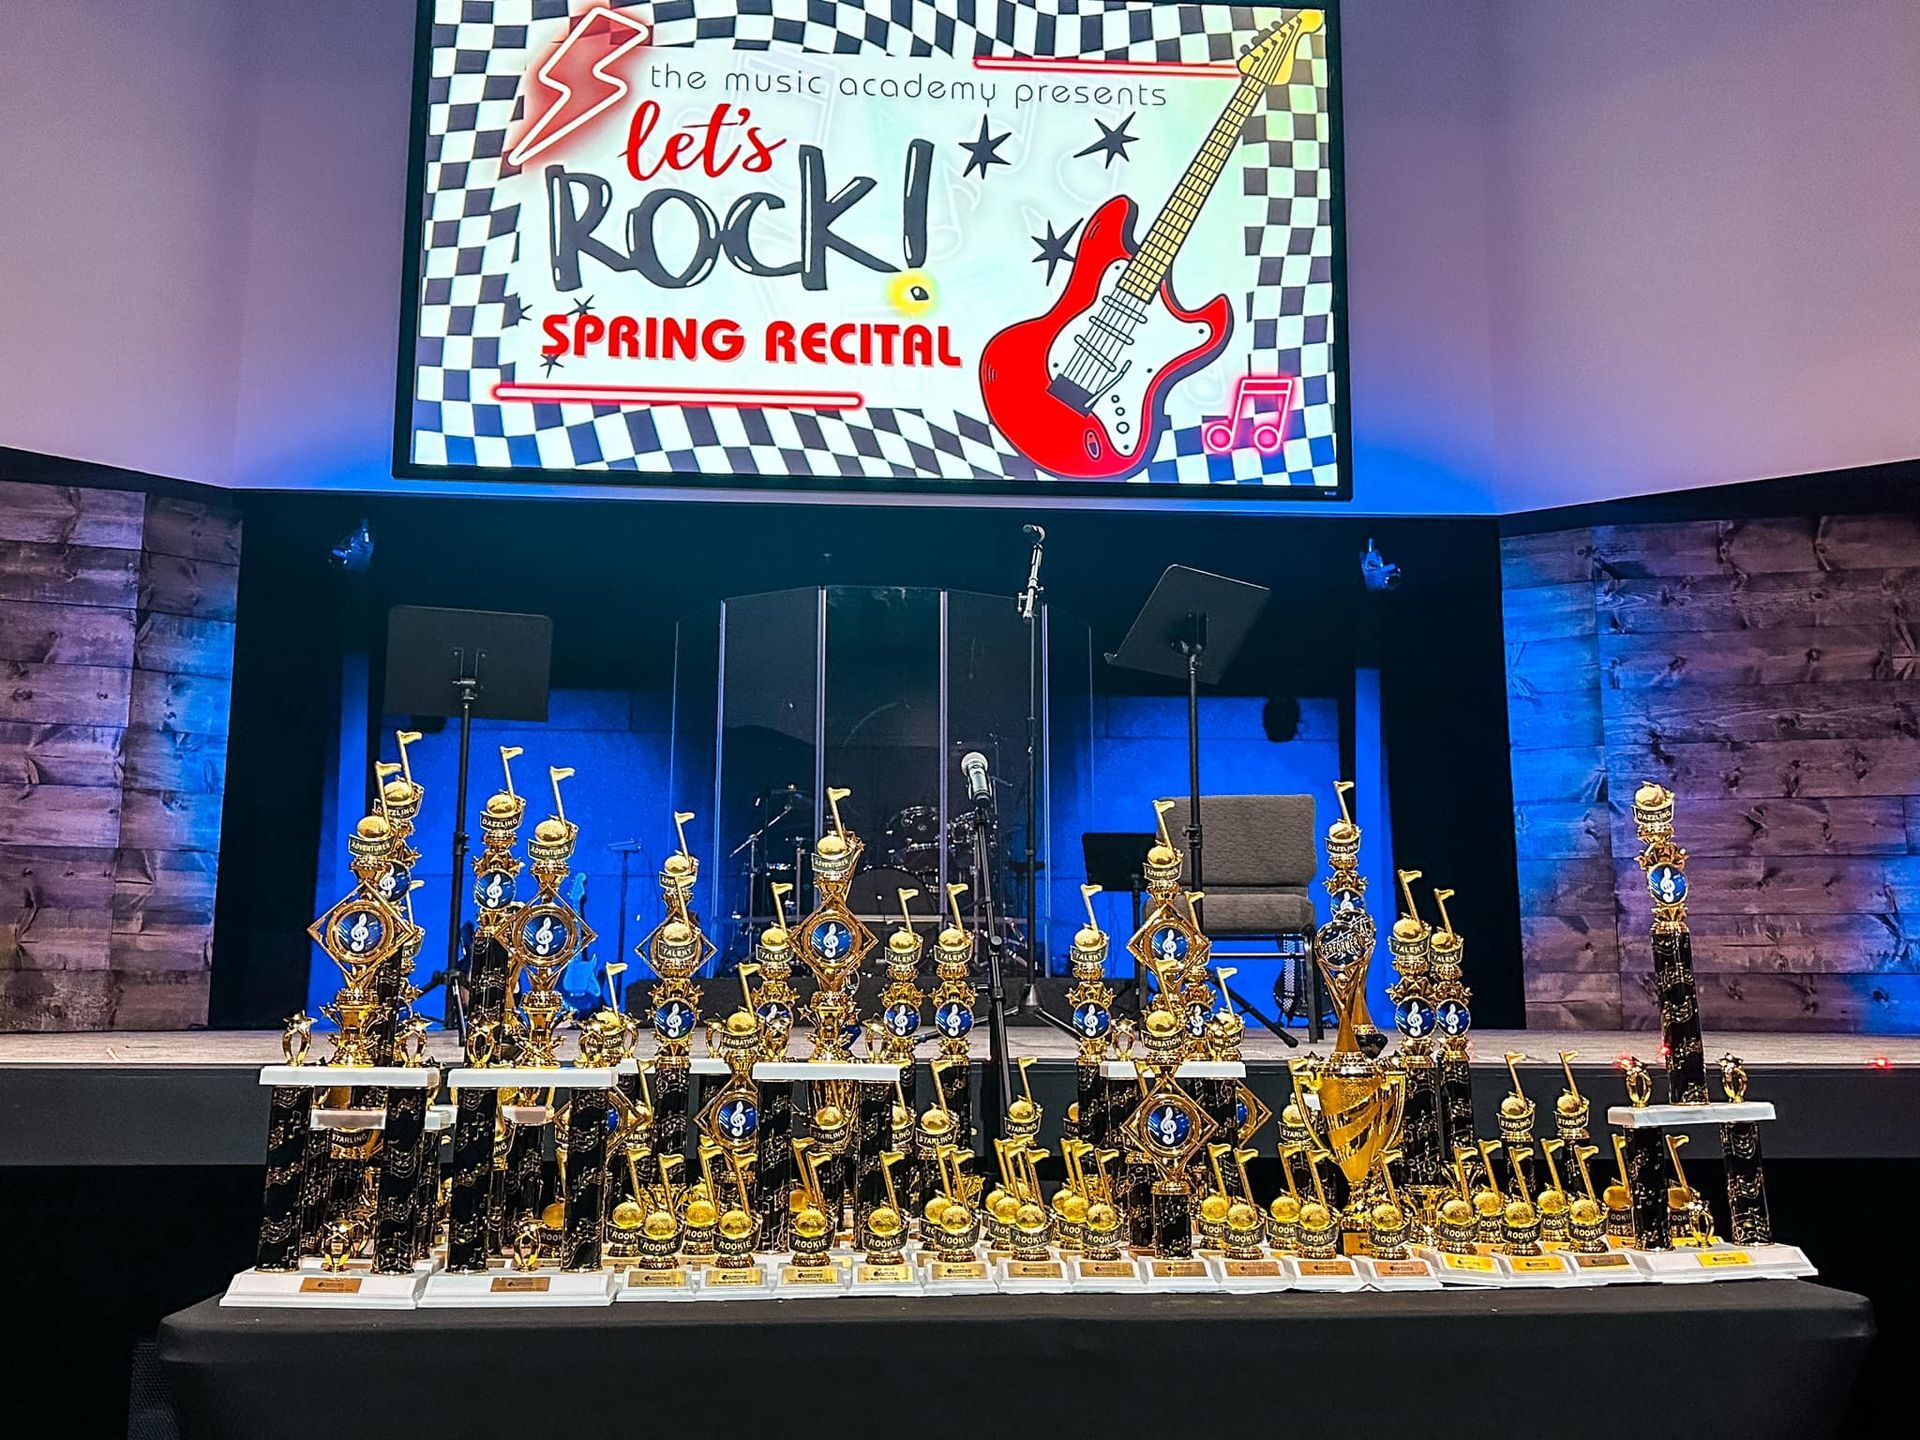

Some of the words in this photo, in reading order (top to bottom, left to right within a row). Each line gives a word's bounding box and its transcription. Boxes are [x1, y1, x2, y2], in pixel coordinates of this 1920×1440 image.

[651, 63, 707, 91] the
[725, 69, 822, 96] music
[839, 73, 997, 108] academy
[1015, 83, 1167, 109] presents
[618, 99, 787, 181] let's
[545, 138, 935, 301] ROCK!
[542, 314, 745, 362] SPRING
[765, 321, 963, 368] RECITAL
[1637, 810, 1672, 821] DAZZLING
[663, 947, 692, 957] TALENT
[1395, 943, 1425, 954] TALENT
[1443, 1229, 1473, 1238] ROOKIE
[1506, 1230, 1537, 1239] ROOKIE
[1573, 1228, 1604, 1237] ROOKIE
[795, 1238, 827, 1248] ROOKIE
[869, 1238, 901, 1248] ROOKIE
[941, 1233, 973, 1245] ROOKIE
[1015, 1234, 1047, 1244] ROOKIE
[1087, 1233, 1118, 1243] ROOKIE
[1229, 1233, 1260, 1243] ROOKIE
[1301, 1233, 1331, 1243] ROOKIE
[1374, 1234, 1405, 1243] ROOKIE
[642, 1241, 676, 1252] ROOKIE
[718, 1240, 752, 1250] ROOKIE
